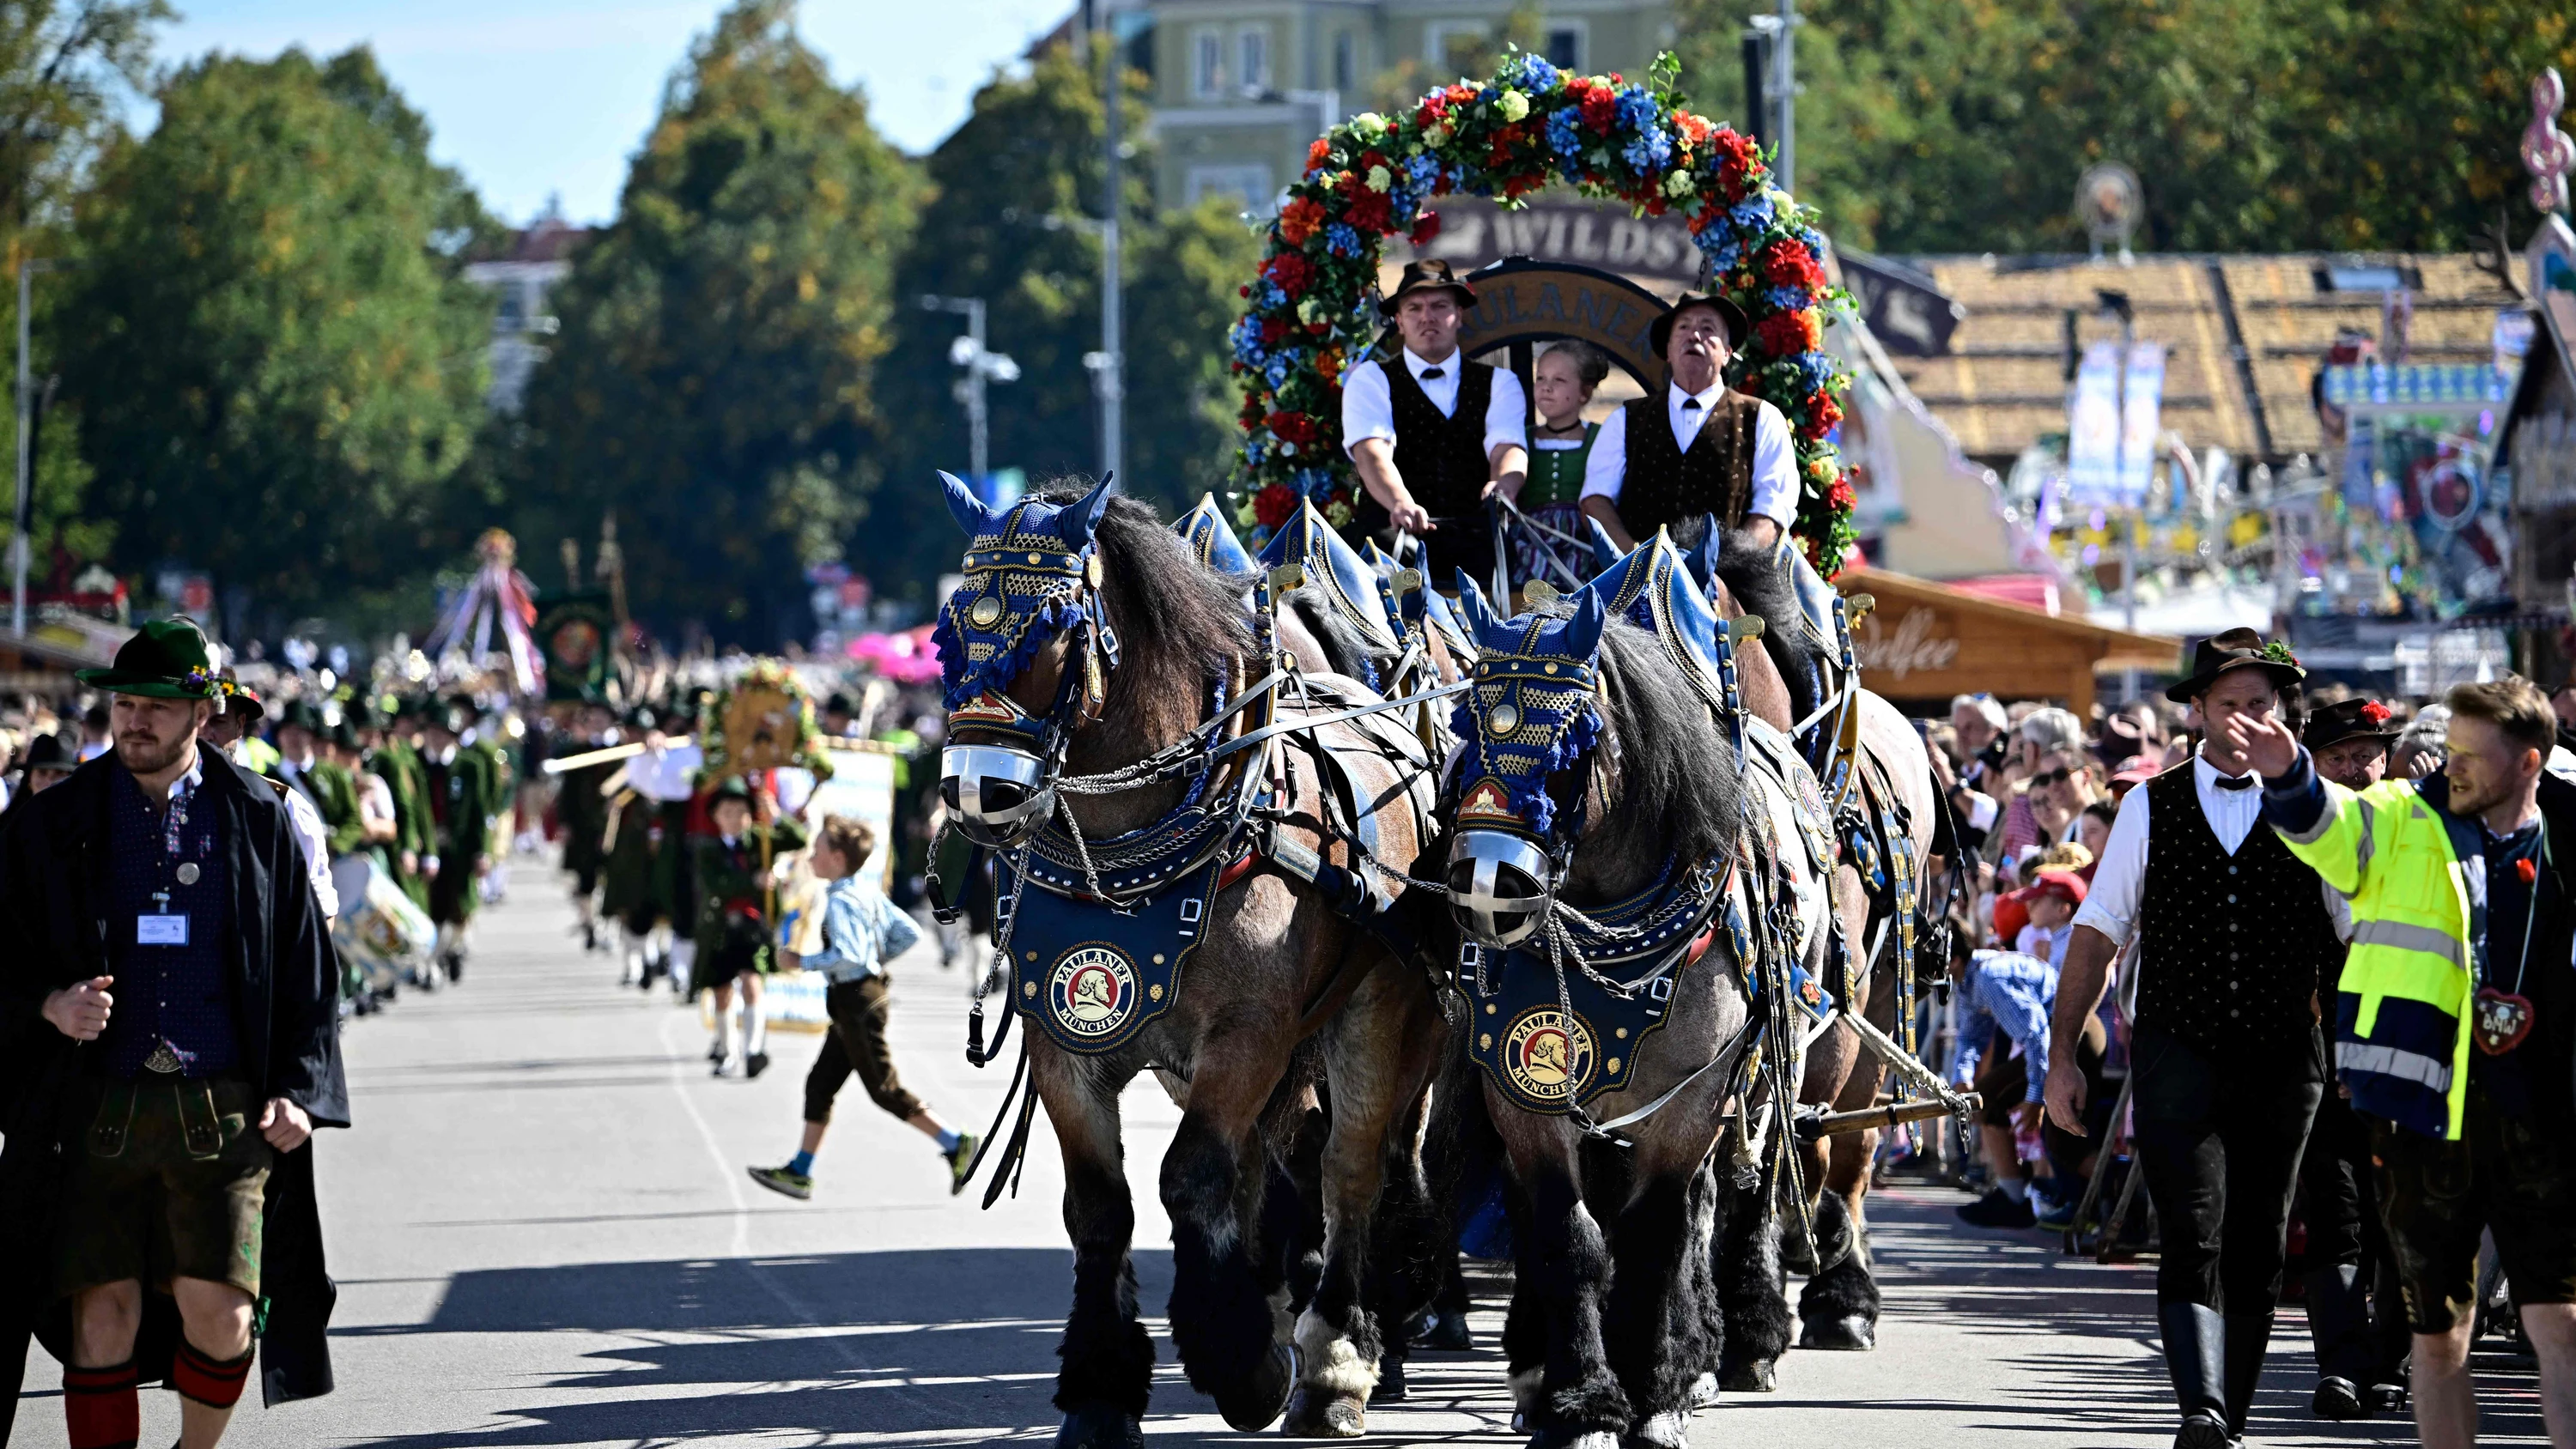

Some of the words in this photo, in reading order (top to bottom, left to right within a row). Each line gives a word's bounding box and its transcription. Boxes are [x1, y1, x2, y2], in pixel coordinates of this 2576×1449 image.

[1459, 282, 1654, 363] ULANER
[1055, 950, 1131, 986] PAULANER
[1060, 1007, 1124, 1032] MÜNCHEN
[1513, 1015, 1589, 1055] PAULAER
[1513, 1065, 1579, 1095] MÜNCHE
